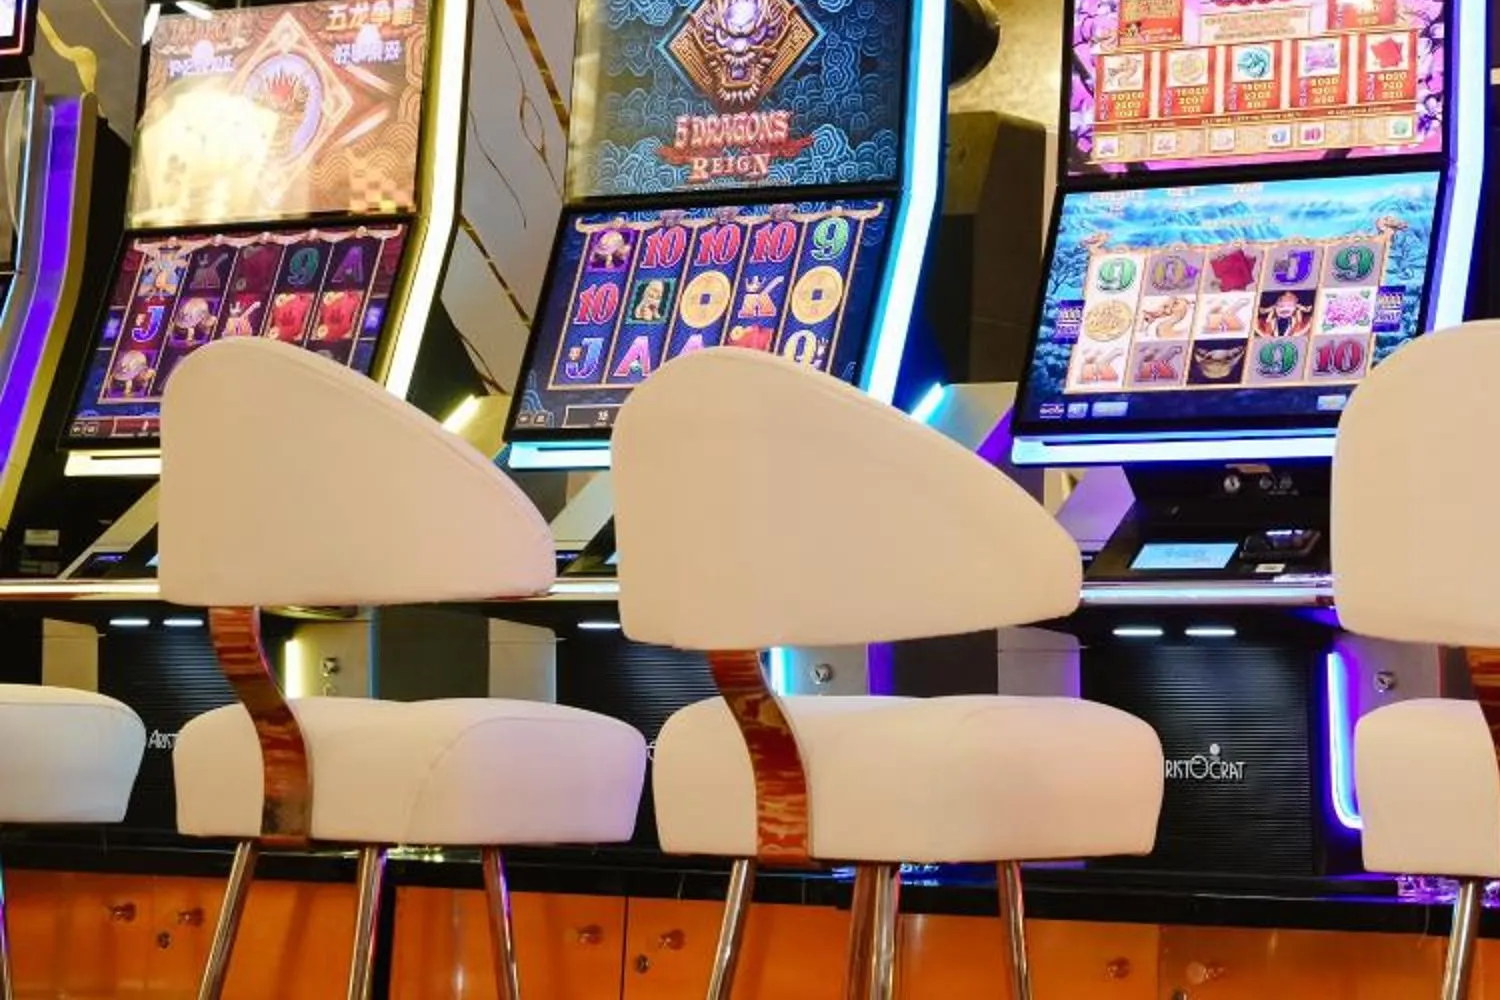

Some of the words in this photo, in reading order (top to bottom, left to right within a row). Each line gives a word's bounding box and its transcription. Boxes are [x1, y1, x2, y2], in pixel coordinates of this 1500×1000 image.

[691, 110, 794, 146] DRAGONS
[688, 153, 771, 181] REIGN
[641, 226, 687, 269] 10
[695, 223, 741, 266] 10
[750, 220, 796, 263] 10
[811, 217, 850, 261] 9
[287, 247, 320, 285] 9
[331, 246, 364, 283] A
[1097, 256, 1137, 292] 9
[1331, 246, 1376, 282] 9
[574, 281, 619, 324] 10
[565, 337, 604, 378] J
[613, 336, 652, 378] A
[1255, 339, 1300, 378] 9
[1313, 338, 1366, 376] 10
[1165, 753, 1246, 780] RISTOCRAT
